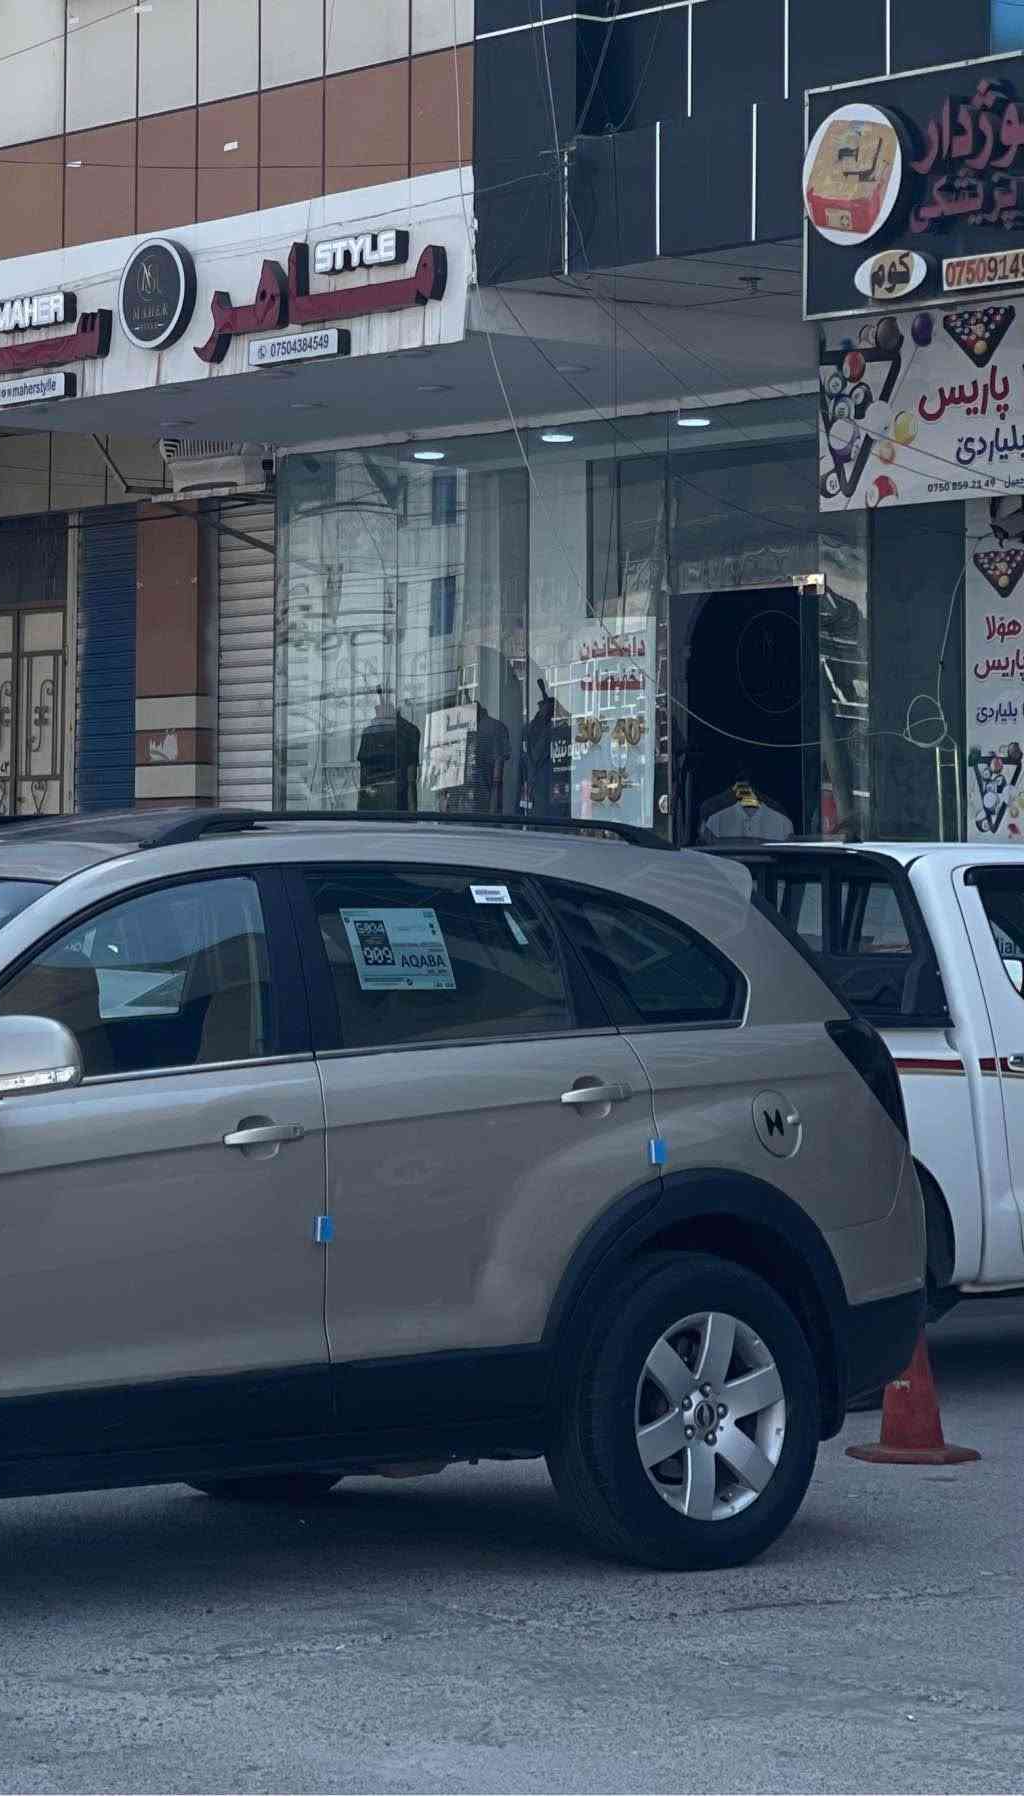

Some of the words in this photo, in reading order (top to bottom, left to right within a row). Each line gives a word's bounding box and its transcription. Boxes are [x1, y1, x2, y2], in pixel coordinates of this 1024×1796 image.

[313, 228, 397, 275] STYLE
[270, 333, 330, 358] 07504384549
[400, 953, 448, 969] AQABA
